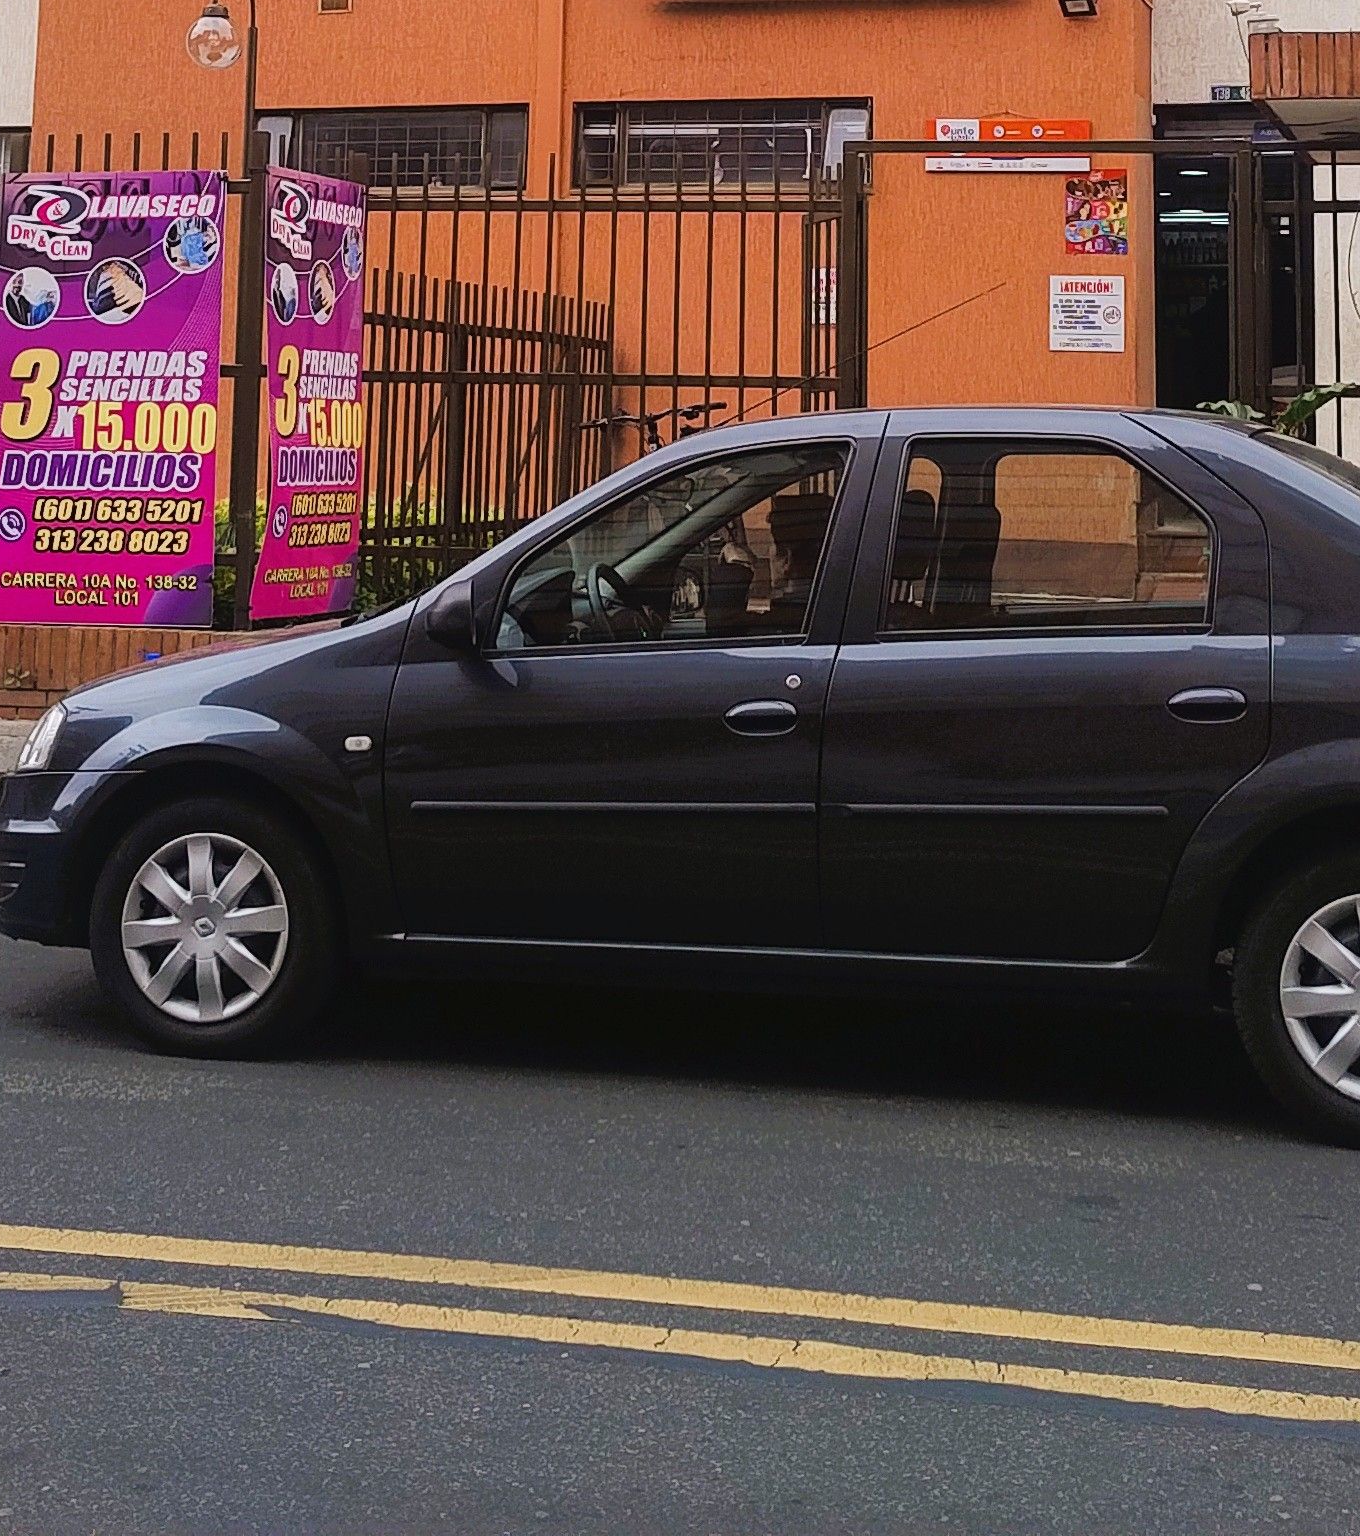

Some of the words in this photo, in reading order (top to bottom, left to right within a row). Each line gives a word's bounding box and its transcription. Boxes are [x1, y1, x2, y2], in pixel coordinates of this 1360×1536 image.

[89, 194, 216, 218] LAVASECO
[310, 199, 362, 228] LAVASECO
[38, 234, 47, 248] &
[66, 350, 208, 378] PRENDAS
[301, 349, 359, 378] PRENDAS
[0, 348, 61, 440] 3
[59, 378, 203, 402] SENCILLAS
[275, 345, 300, 436] 3
[300, 375, 357, 401] SENCILLAS
[77, 401, 217, 454] 15.000
[307, 399, 363, 449] 15.000
[1, 452, 200, 490] DOMICILIOS
[278, 448, 356, 484] DOMICILIOS
[33, 498, 93, 521] (601)
[96, 499, 142, 522] 633
[146, 500, 203, 523] 5201
[35, 529, 76, 551] 313
[79, 529, 126, 552] 238
[128, 530, 189, 553] 8023
[289, 524, 308, 546] 313
[308, 523, 327, 545] 238
[1, 572, 78, 588] CARRERA
[82, 573, 111, 589] 10A
[146, 575, 197, 590] 138-32
[289, 584, 315, 598] LOCAL
[55, 590, 108, 605] LOCAL
[113, 591, 139, 606] 101
